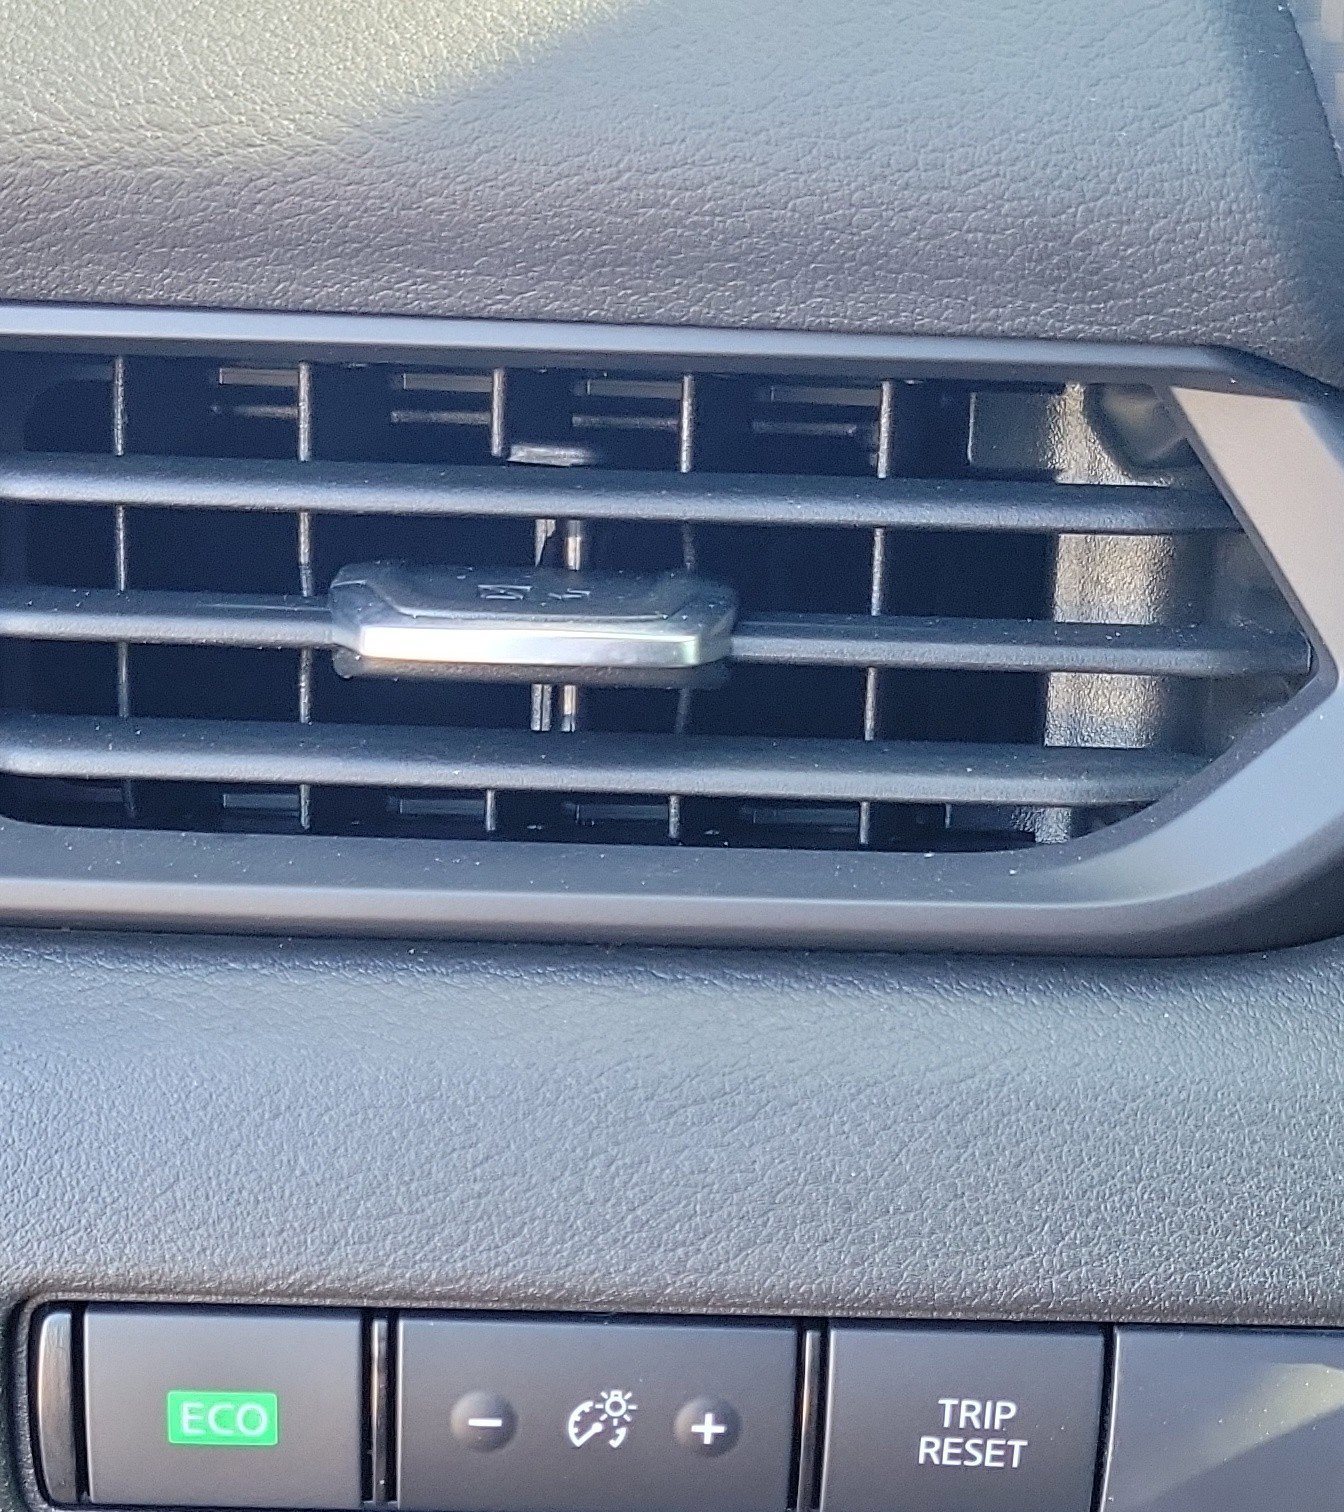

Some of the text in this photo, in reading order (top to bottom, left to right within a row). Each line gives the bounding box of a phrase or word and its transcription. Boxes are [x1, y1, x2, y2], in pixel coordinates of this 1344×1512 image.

[181, 1402, 269, 1437] ECO
[938, 1398, 1018, 1430] TRIP
[918, 1436, 1029, 1468] RESET
